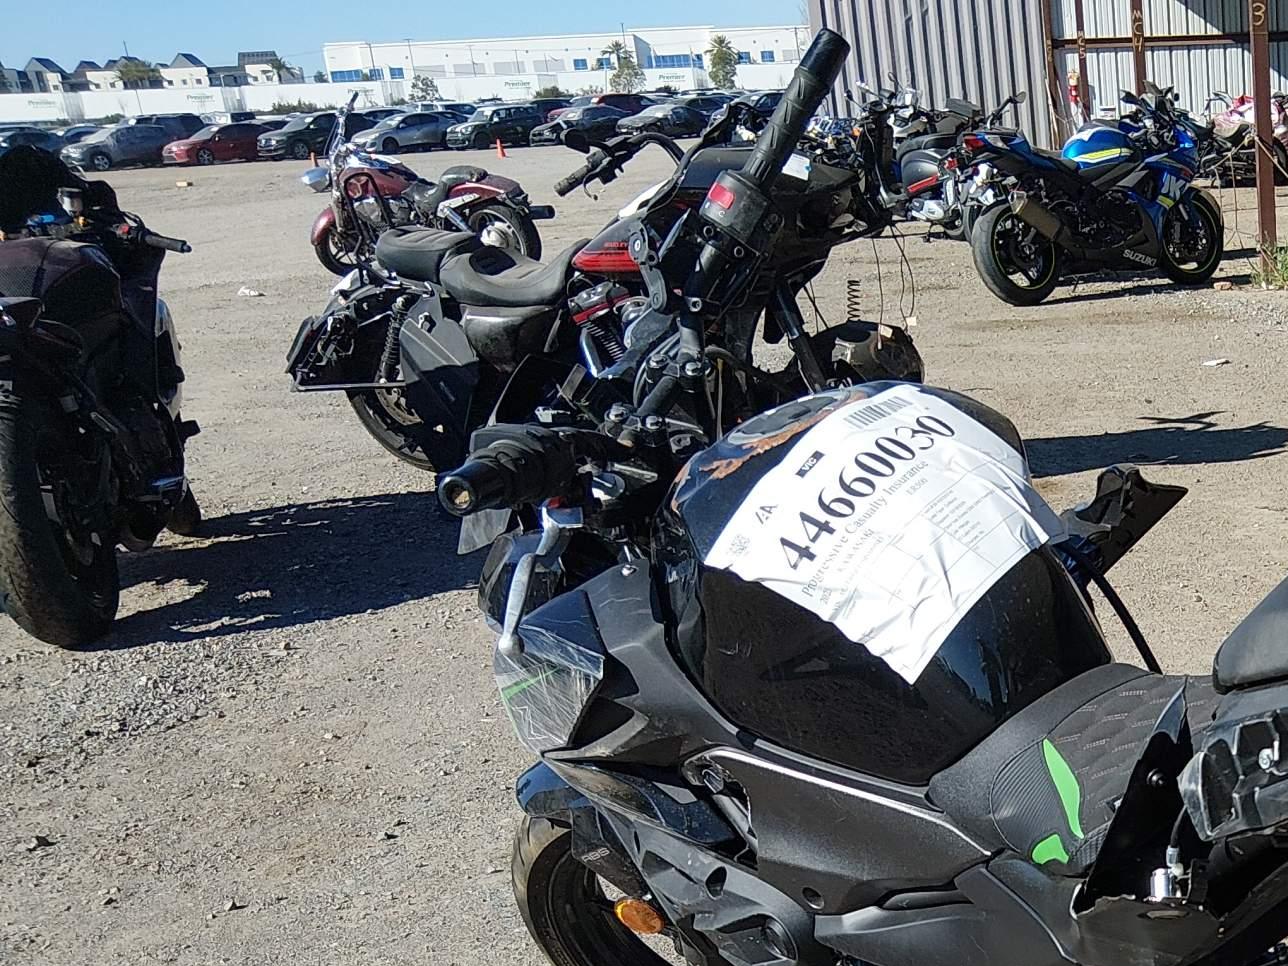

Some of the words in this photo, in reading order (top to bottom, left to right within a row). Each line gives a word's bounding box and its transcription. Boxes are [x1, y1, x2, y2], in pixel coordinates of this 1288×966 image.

[1252, 4, 1266, 25] 3
[1122, 249, 1157, 267] SUZUKI
[801, 456, 817, 472] VIC
[780, 415, 955, 570] 44660030
[801, 535, 849, 597] Progressive
[844, 492, 888, 534] Casualty
[883, 461, 929, 496] Insurance
[581, 847, 610, 861] ABS
